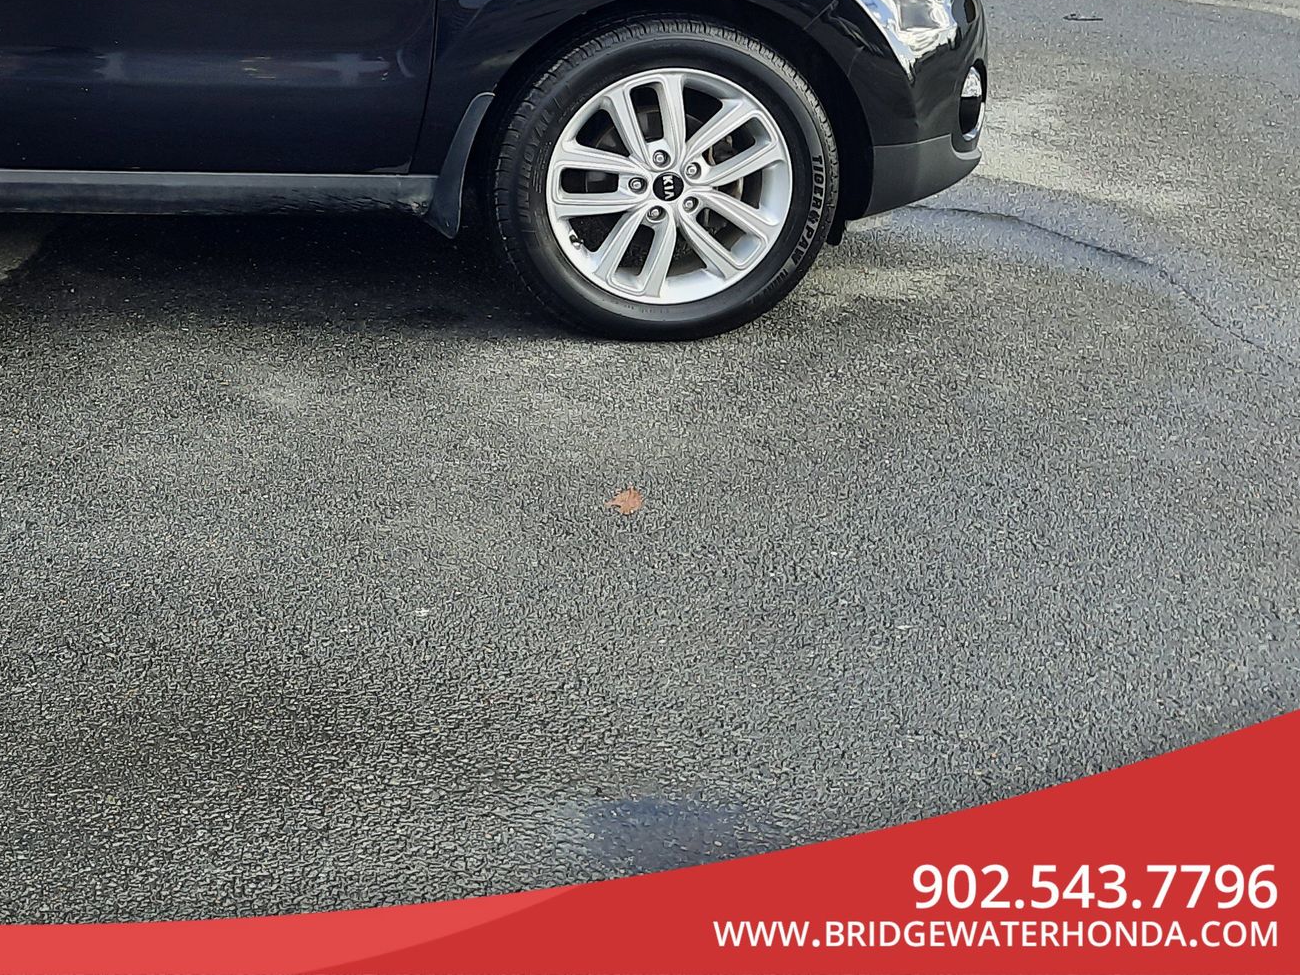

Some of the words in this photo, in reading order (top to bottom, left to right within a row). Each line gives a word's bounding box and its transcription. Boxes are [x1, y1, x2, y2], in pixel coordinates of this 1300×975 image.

[662, 175, 675, 200] KIA
[811, 155, 826, 210] TIGER
[790, 225, 815, 266] PAW
